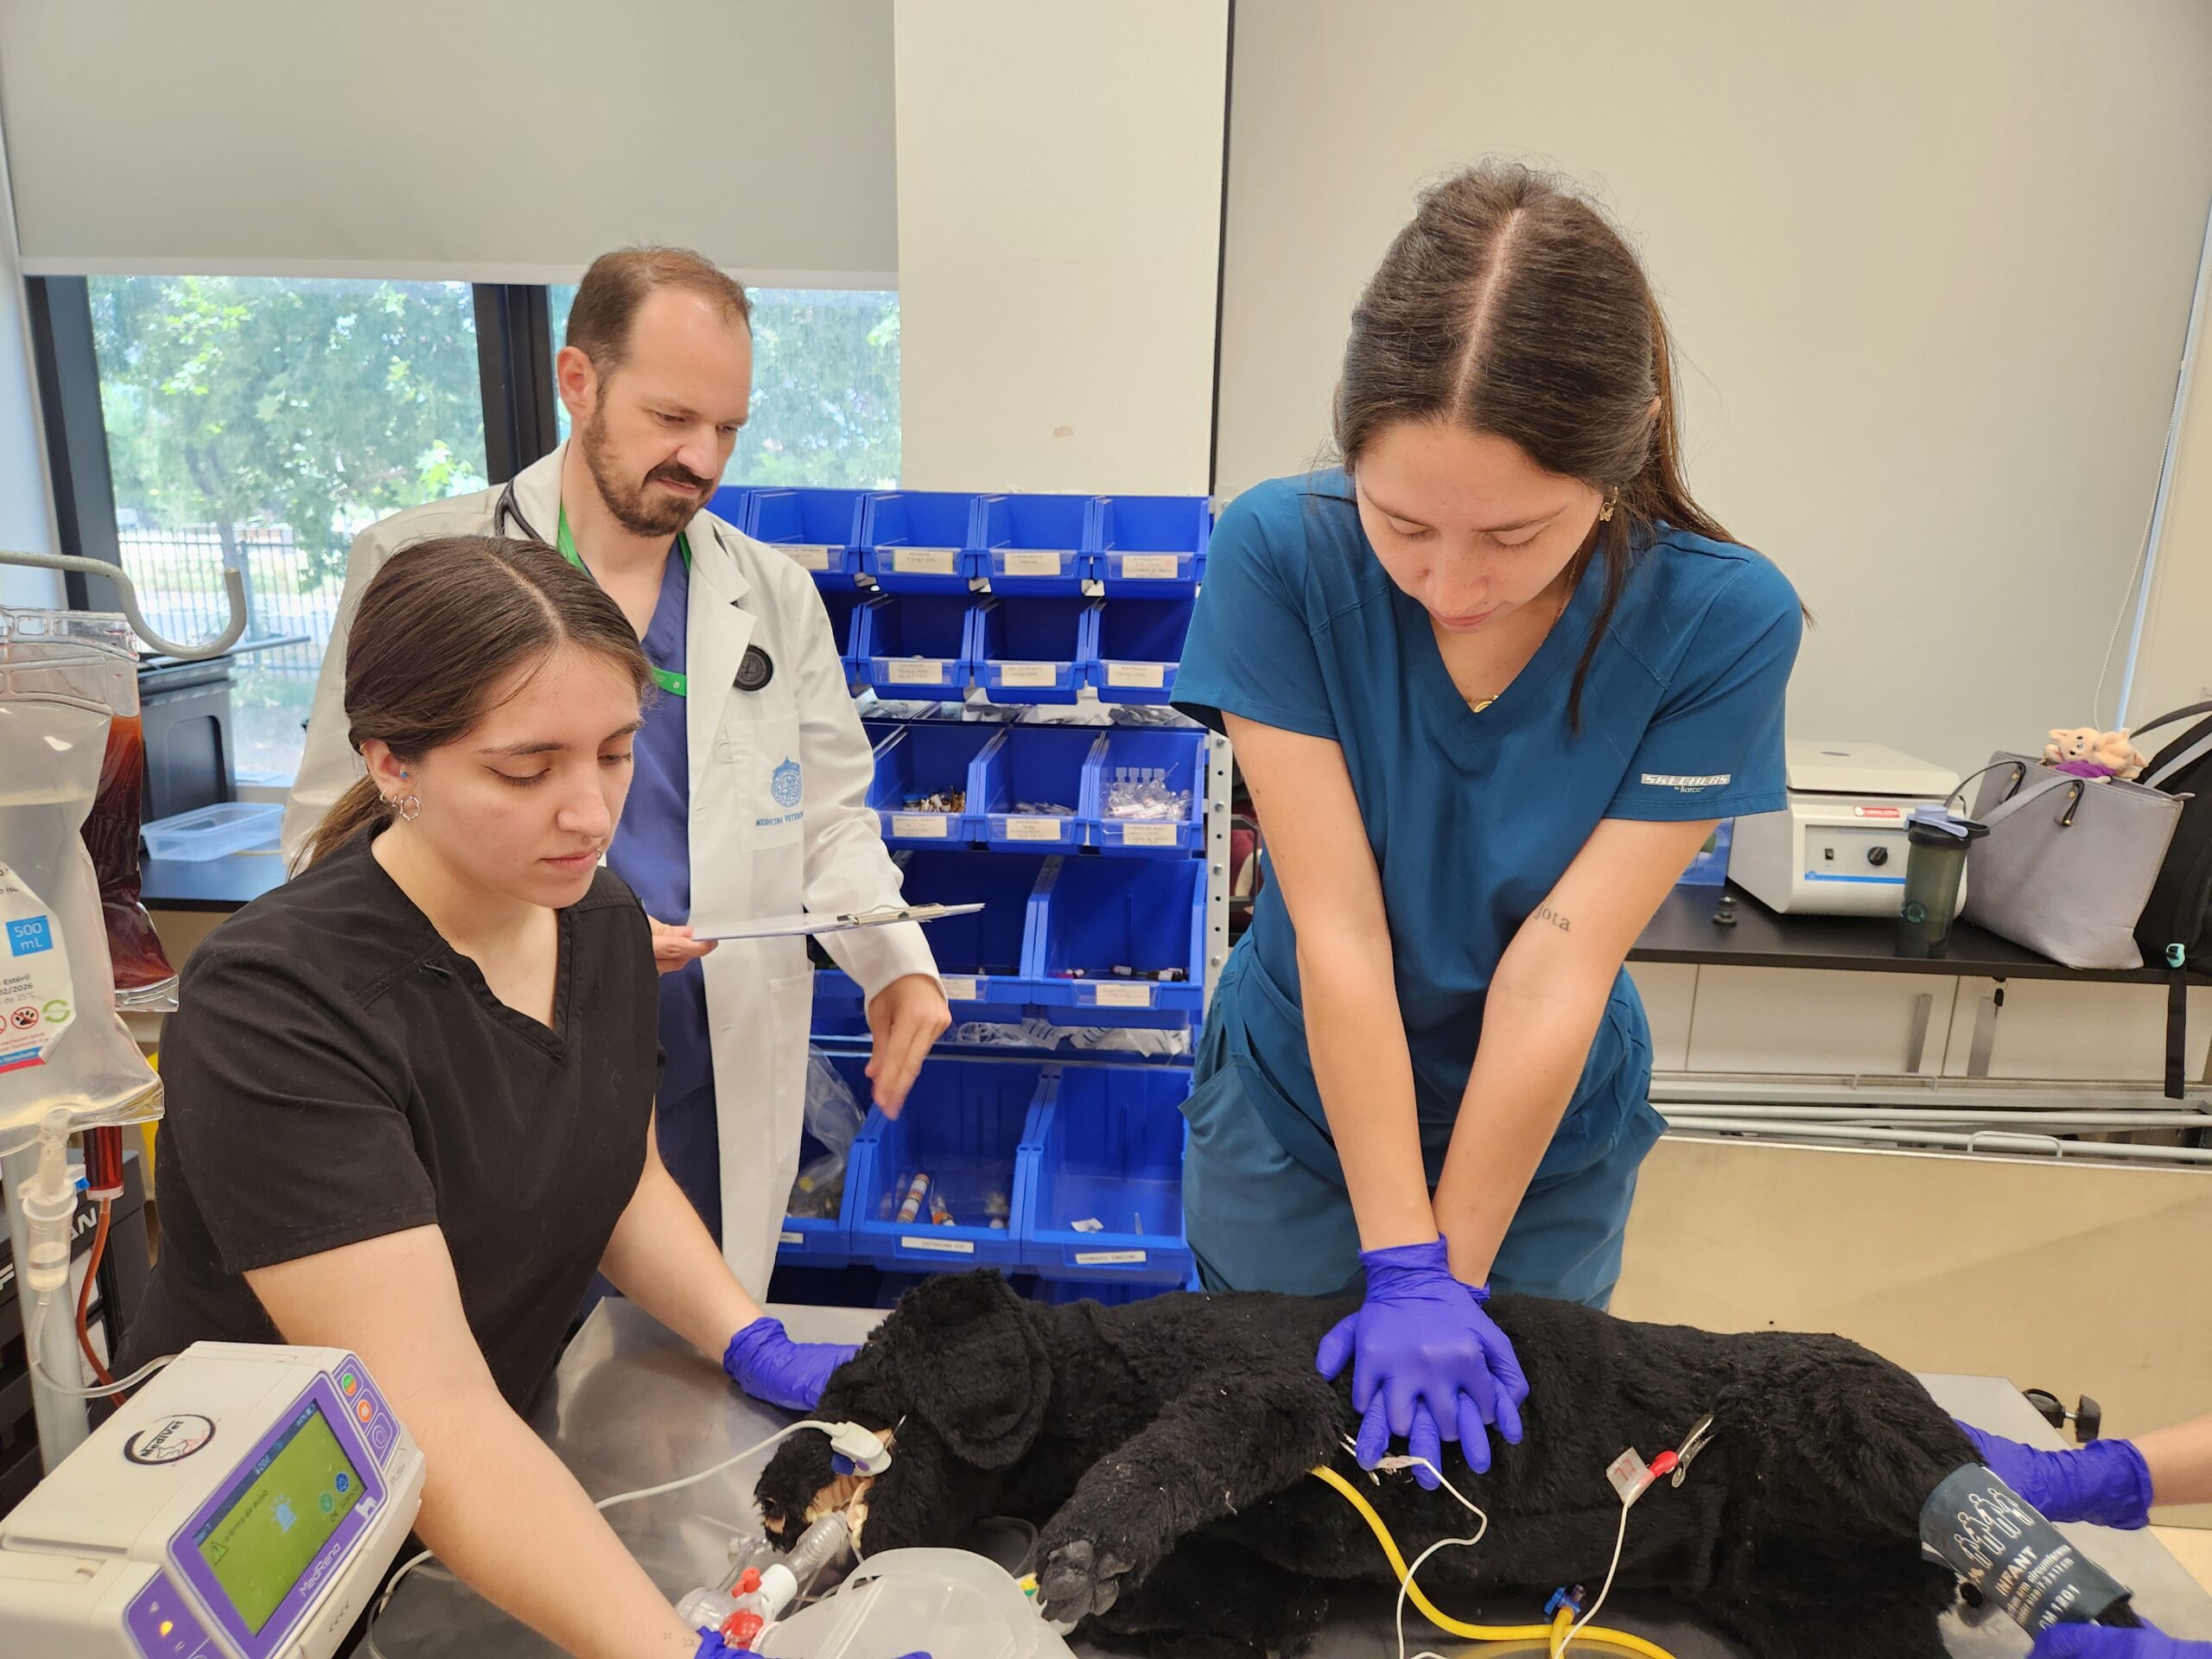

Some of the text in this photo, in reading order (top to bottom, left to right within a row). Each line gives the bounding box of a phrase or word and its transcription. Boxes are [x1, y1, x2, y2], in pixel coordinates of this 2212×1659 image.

[14, 922, 42, 938] 500
[21, 937, 43, 950] mL
[1995, 1546, 2037, 1597] INFANT
